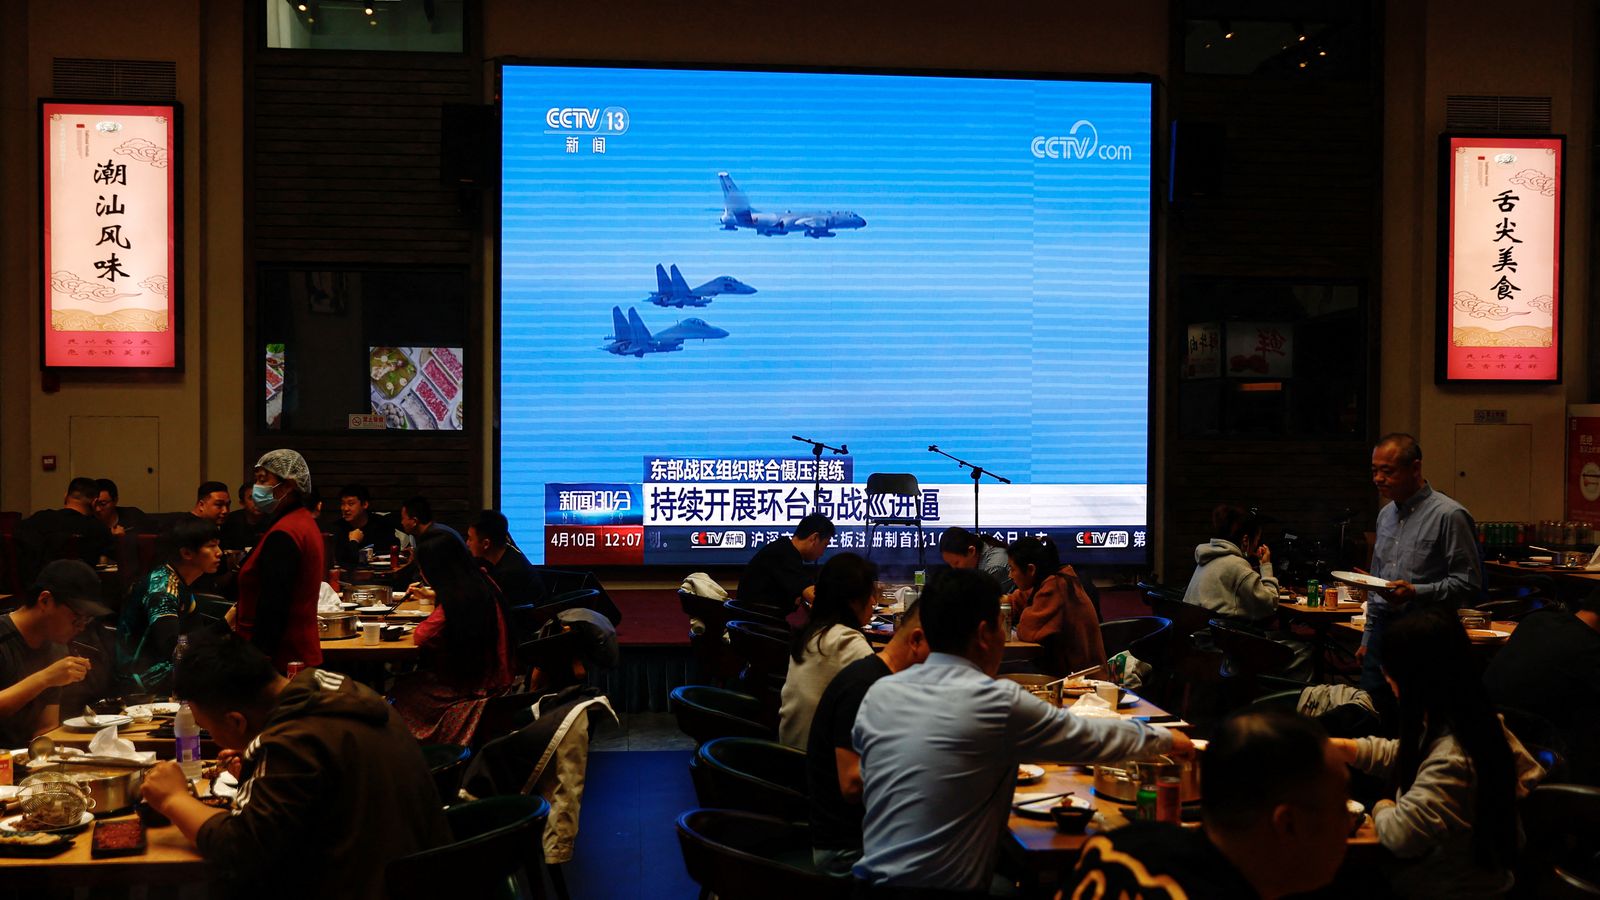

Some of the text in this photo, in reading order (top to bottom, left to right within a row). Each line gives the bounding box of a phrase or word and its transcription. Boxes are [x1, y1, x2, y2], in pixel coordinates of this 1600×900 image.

[546, 107, 624, 131] CCTV 13
[566, 136, 606, 154] 新闻
[93, 159, 132, 283] 潮汕风味
[1489, 189, 1524, 301] 舌尖美食
[650, 458, 845, 482] 东部战区组织联合慑压演练
[559, 490, 632, 511] 新闻30分
[650, 486, 941, 522] 持续开展环台岛战巡进逼
[551, 532, 595, 547] 4月10日
[605, 533, 642, 547] 12:07
[691, 531, 723, 546] CCTV
[724, 532, 745, 546] 新闻
[1076, 531, 1146, 548] CCTV 新闻 第
